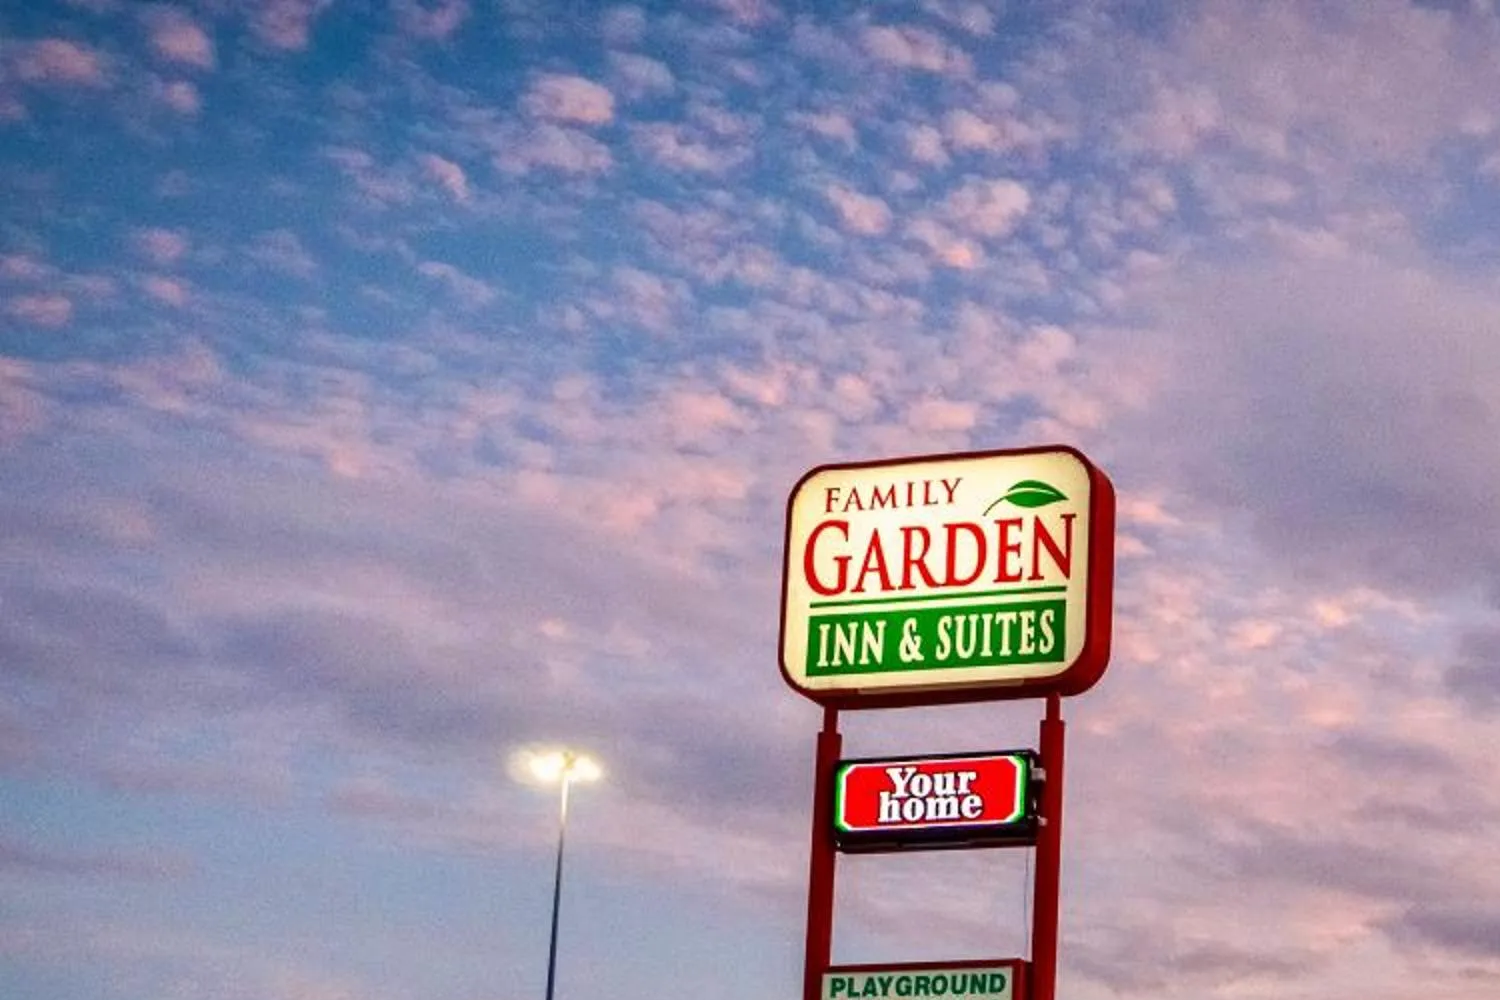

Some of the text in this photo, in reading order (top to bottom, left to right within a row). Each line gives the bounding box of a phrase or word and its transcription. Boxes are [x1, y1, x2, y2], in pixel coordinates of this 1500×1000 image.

[824, 477, 964, 514] FAMILY
[803, 513, 1077, 597] GARDEN
[816, 609, 1056, 668] INN & SUITES
[885, 767, 977, 799] Your
[877, 791, 983, 823] home
[830, 973, 1007, 998] PLAYGROUND
